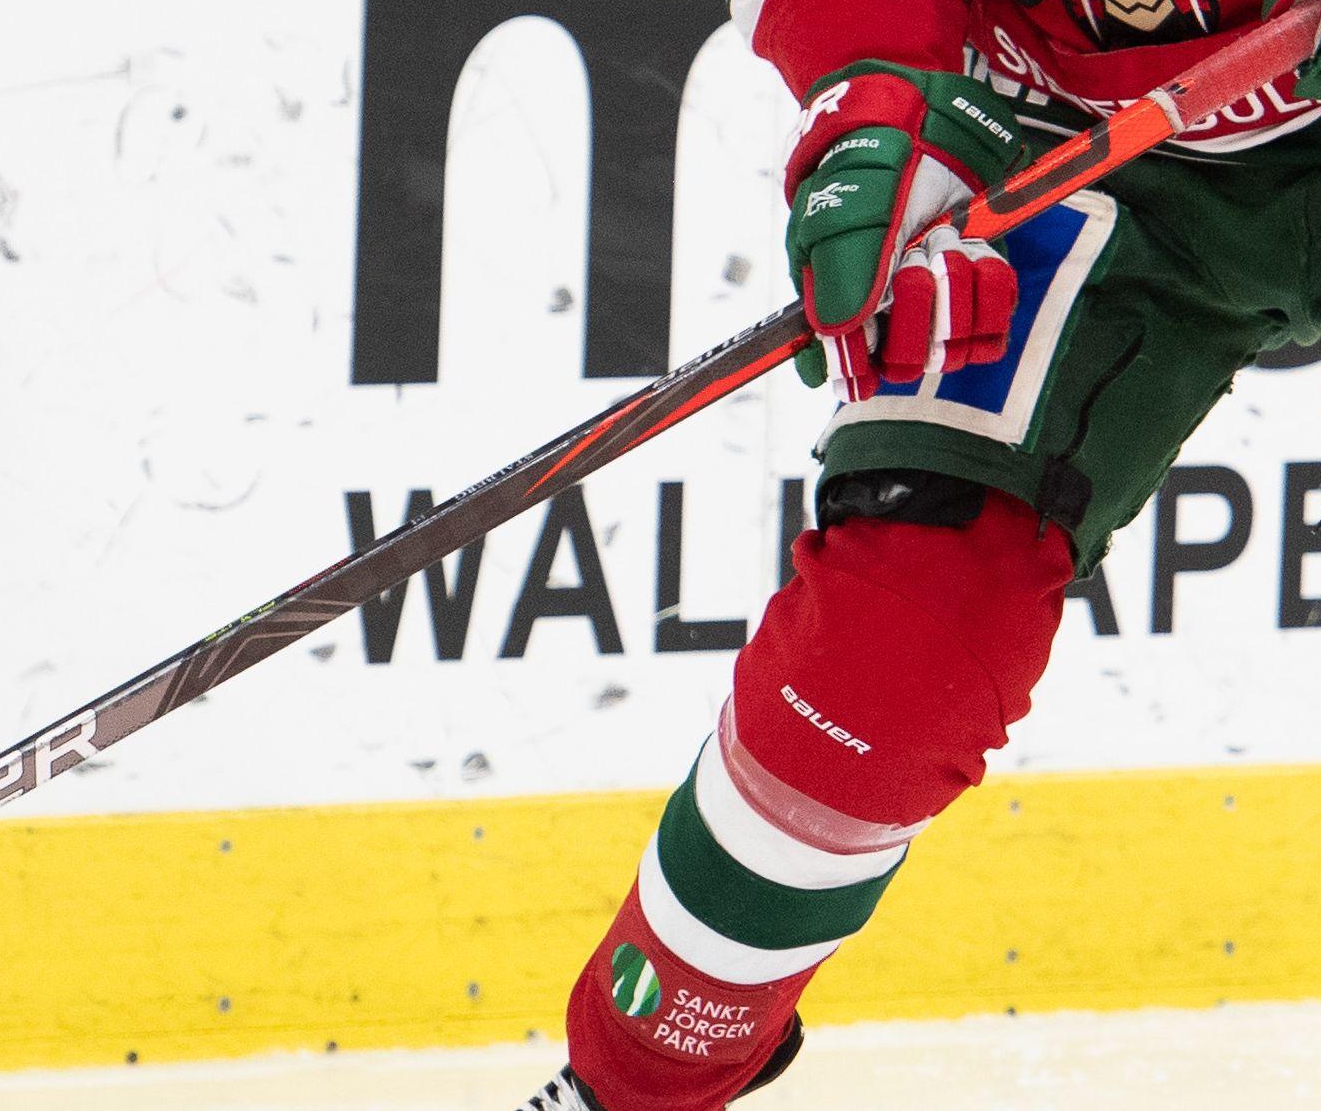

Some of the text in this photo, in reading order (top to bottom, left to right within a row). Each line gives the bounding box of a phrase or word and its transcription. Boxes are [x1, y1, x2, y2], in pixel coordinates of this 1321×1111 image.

[673, 988, 750, 1021] SANKT
[653, 1023, 714, 1057] PARK
[664, 1008, 756, 1039] JÖRGEN
